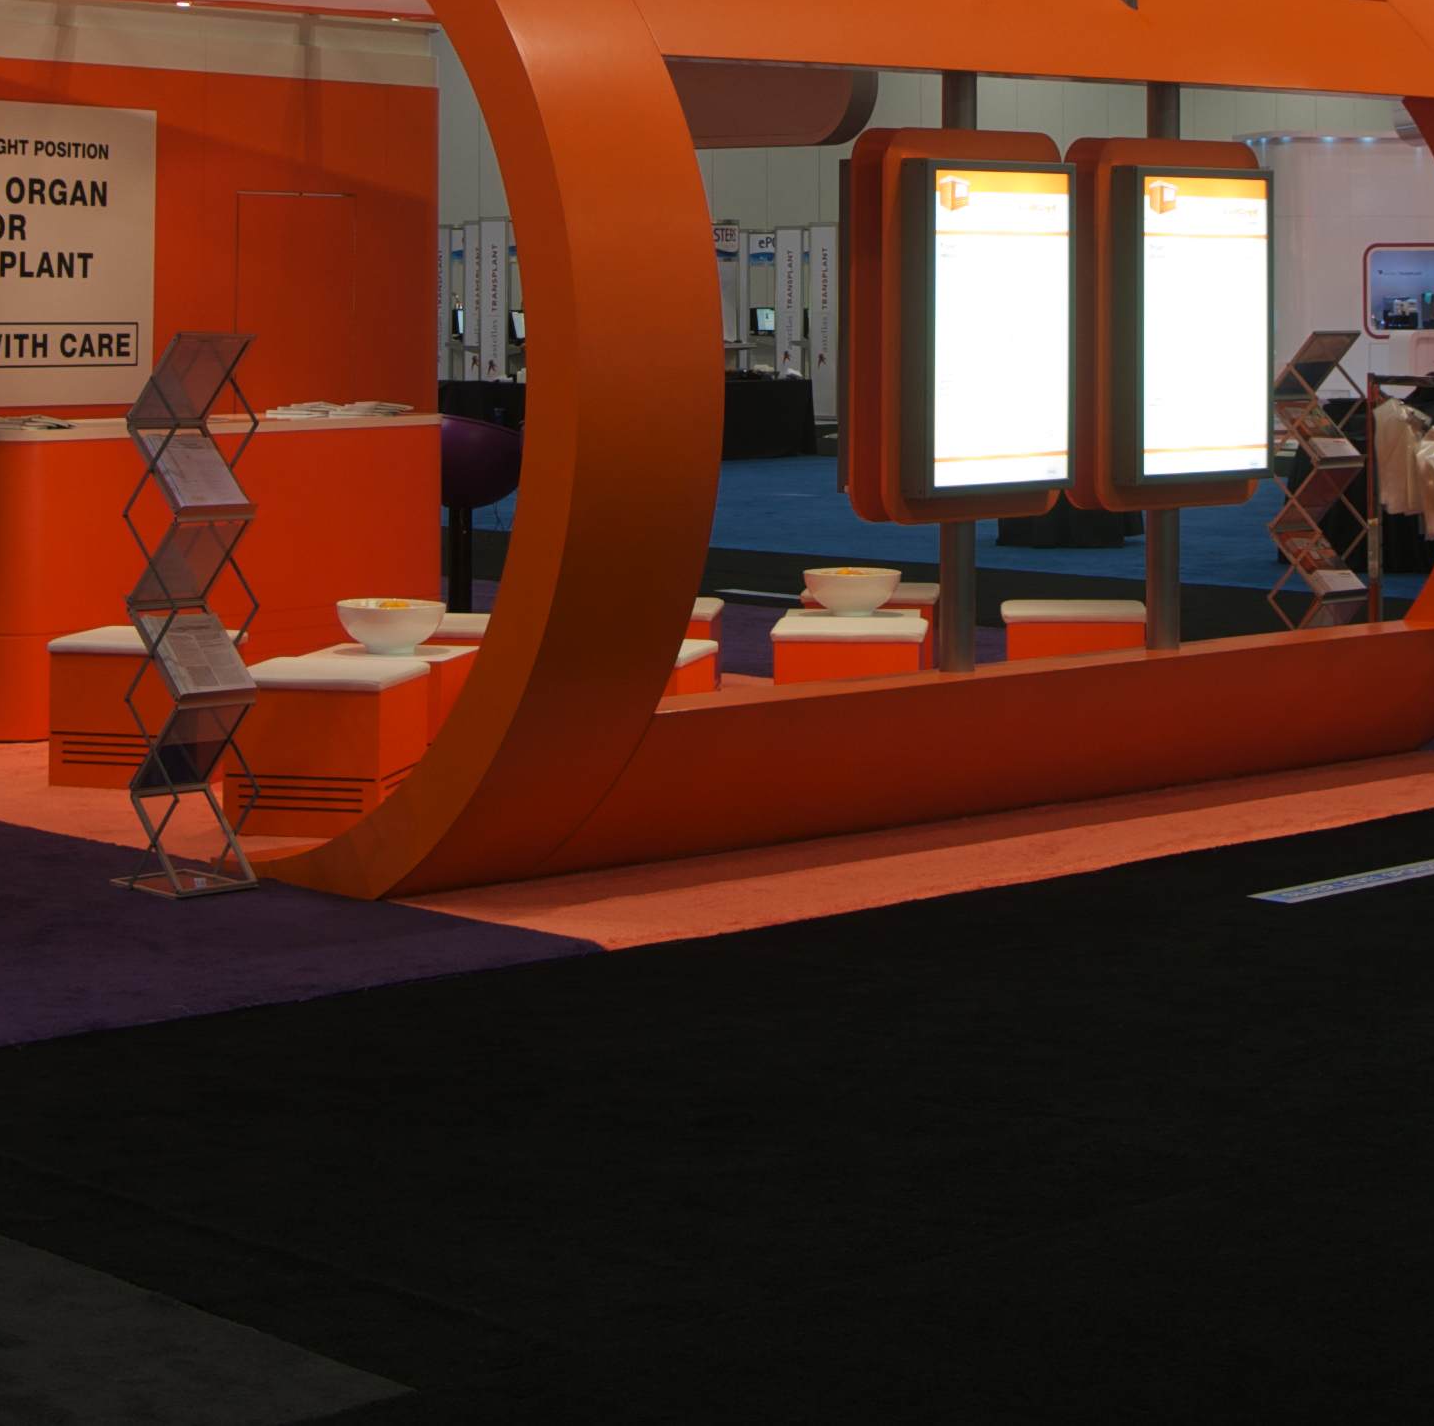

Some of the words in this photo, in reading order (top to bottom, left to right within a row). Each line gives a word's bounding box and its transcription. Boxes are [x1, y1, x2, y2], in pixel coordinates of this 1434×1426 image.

[33, 140, 110, 160] POSITION
[4, 176, 108, 208] ORGAN
[59, 331, 132, 358] CARE
